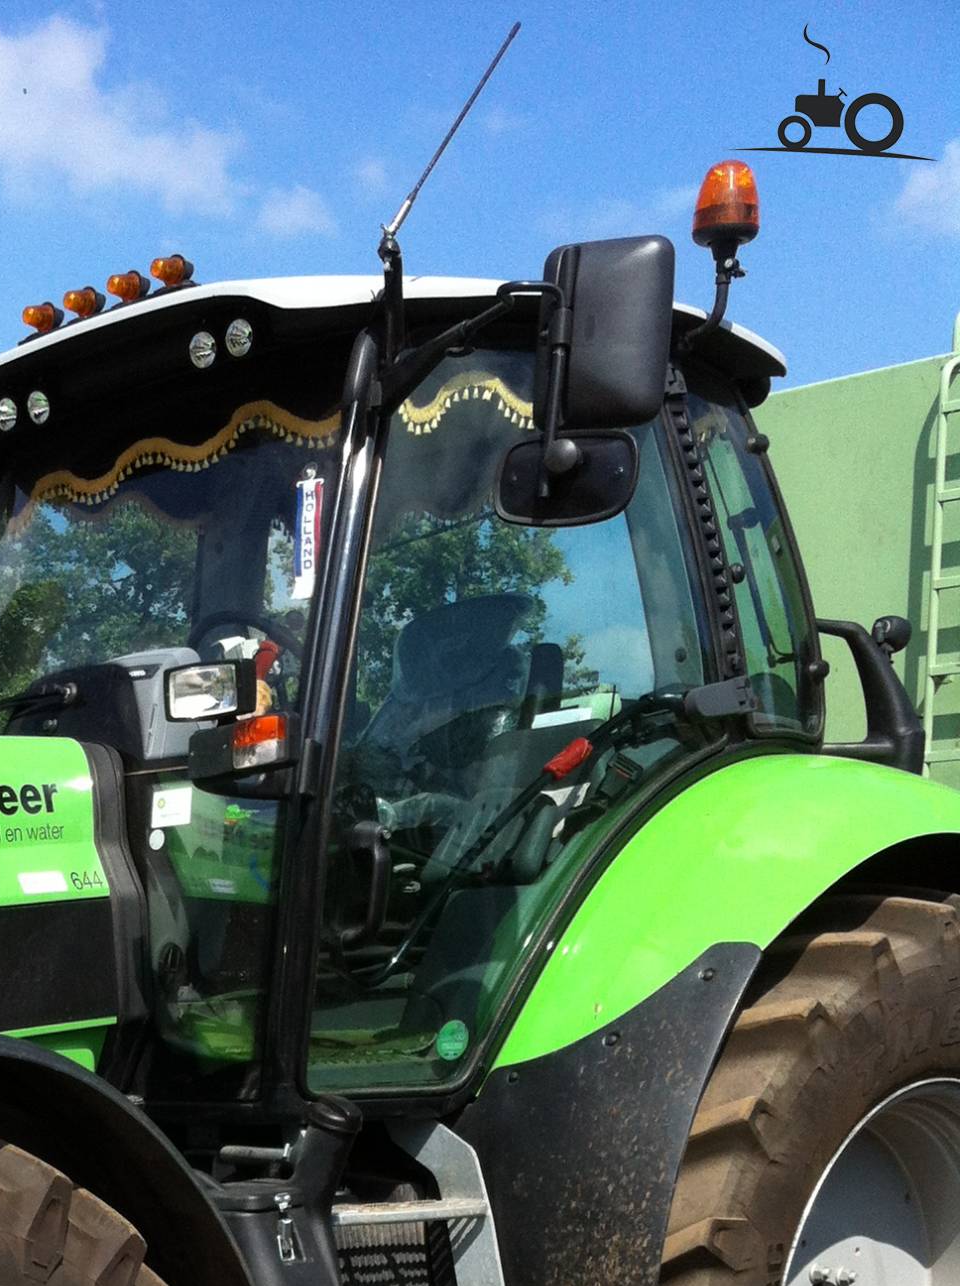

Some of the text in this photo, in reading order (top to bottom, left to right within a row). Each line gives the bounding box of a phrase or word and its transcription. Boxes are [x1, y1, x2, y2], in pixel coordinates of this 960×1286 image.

[303, 490, 315, 570] HOLLAND
[5, 829, 23, 843] en
[26, 823, 65, 842] water
[70, 870, 103, 890] 644
